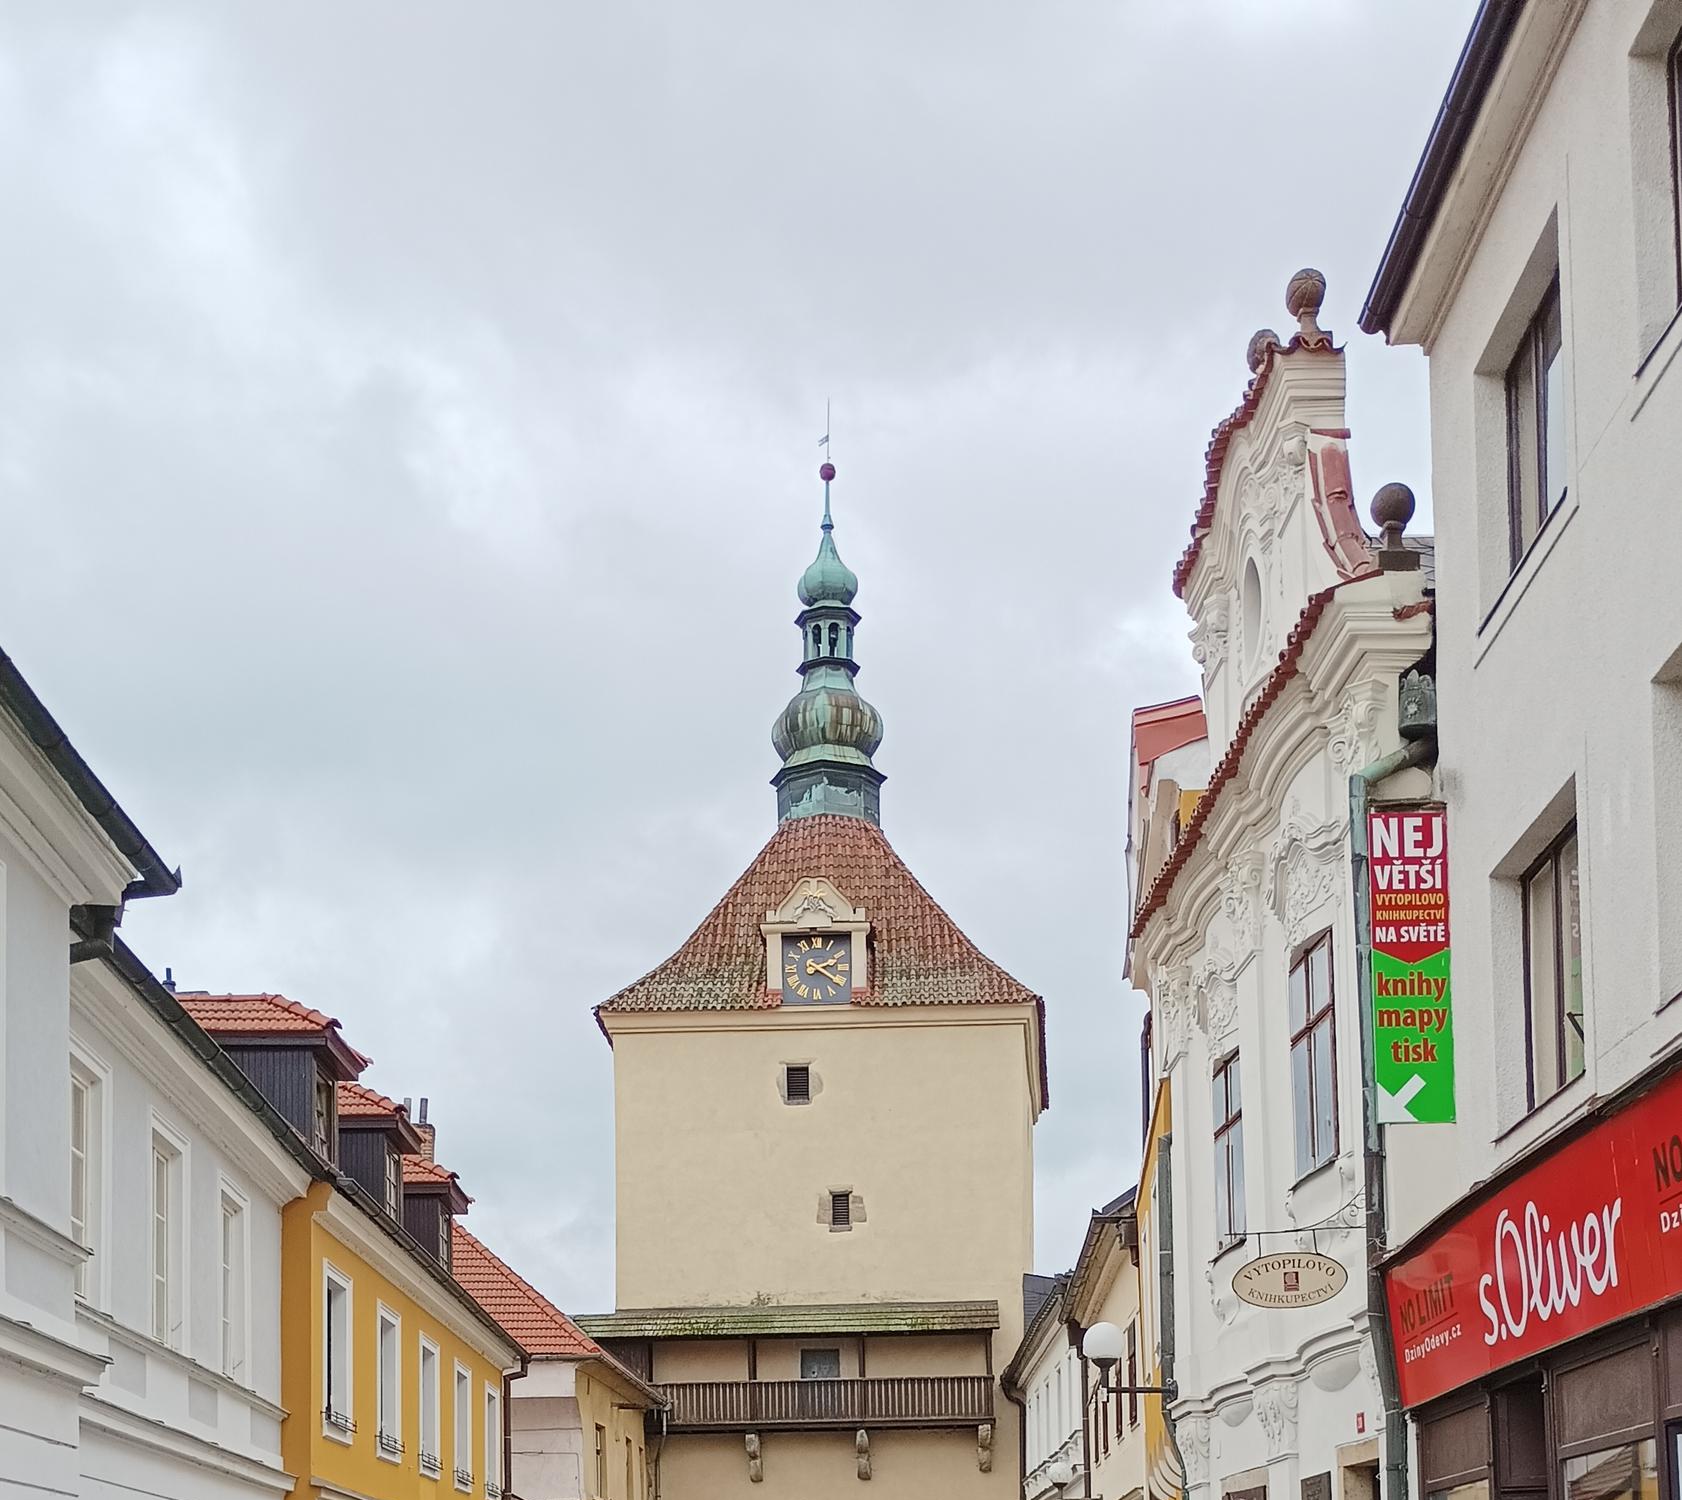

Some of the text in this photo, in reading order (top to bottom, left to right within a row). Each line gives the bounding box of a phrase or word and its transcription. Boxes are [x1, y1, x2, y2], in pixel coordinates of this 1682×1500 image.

[1373, 818, 1443, 858] NEJ
[1374, 860, 1442, 890] VĚTŠÍ
[1375, 893, 1444, 906] VYTOPILOVO
[1376, 908, 1445, 921] KNIHKUPECTVÍ
[1375, 925, 1445, 943] NA SVĚTĚ
[1376, 970, 1447, 1002] knihy
[1377, 1006, 1448, 1033] mapy
[1391, 1037, 1437, 1063] tisk
[1652, 1134, 1682, 1192] NO
[1244, 1258, 1336, 1282] VYTOPILOVO
[1400, 1274, 1454, 1336] NO LIMIT
[1404, 1323, 1462, 1363] DzinyOdevy.cz
